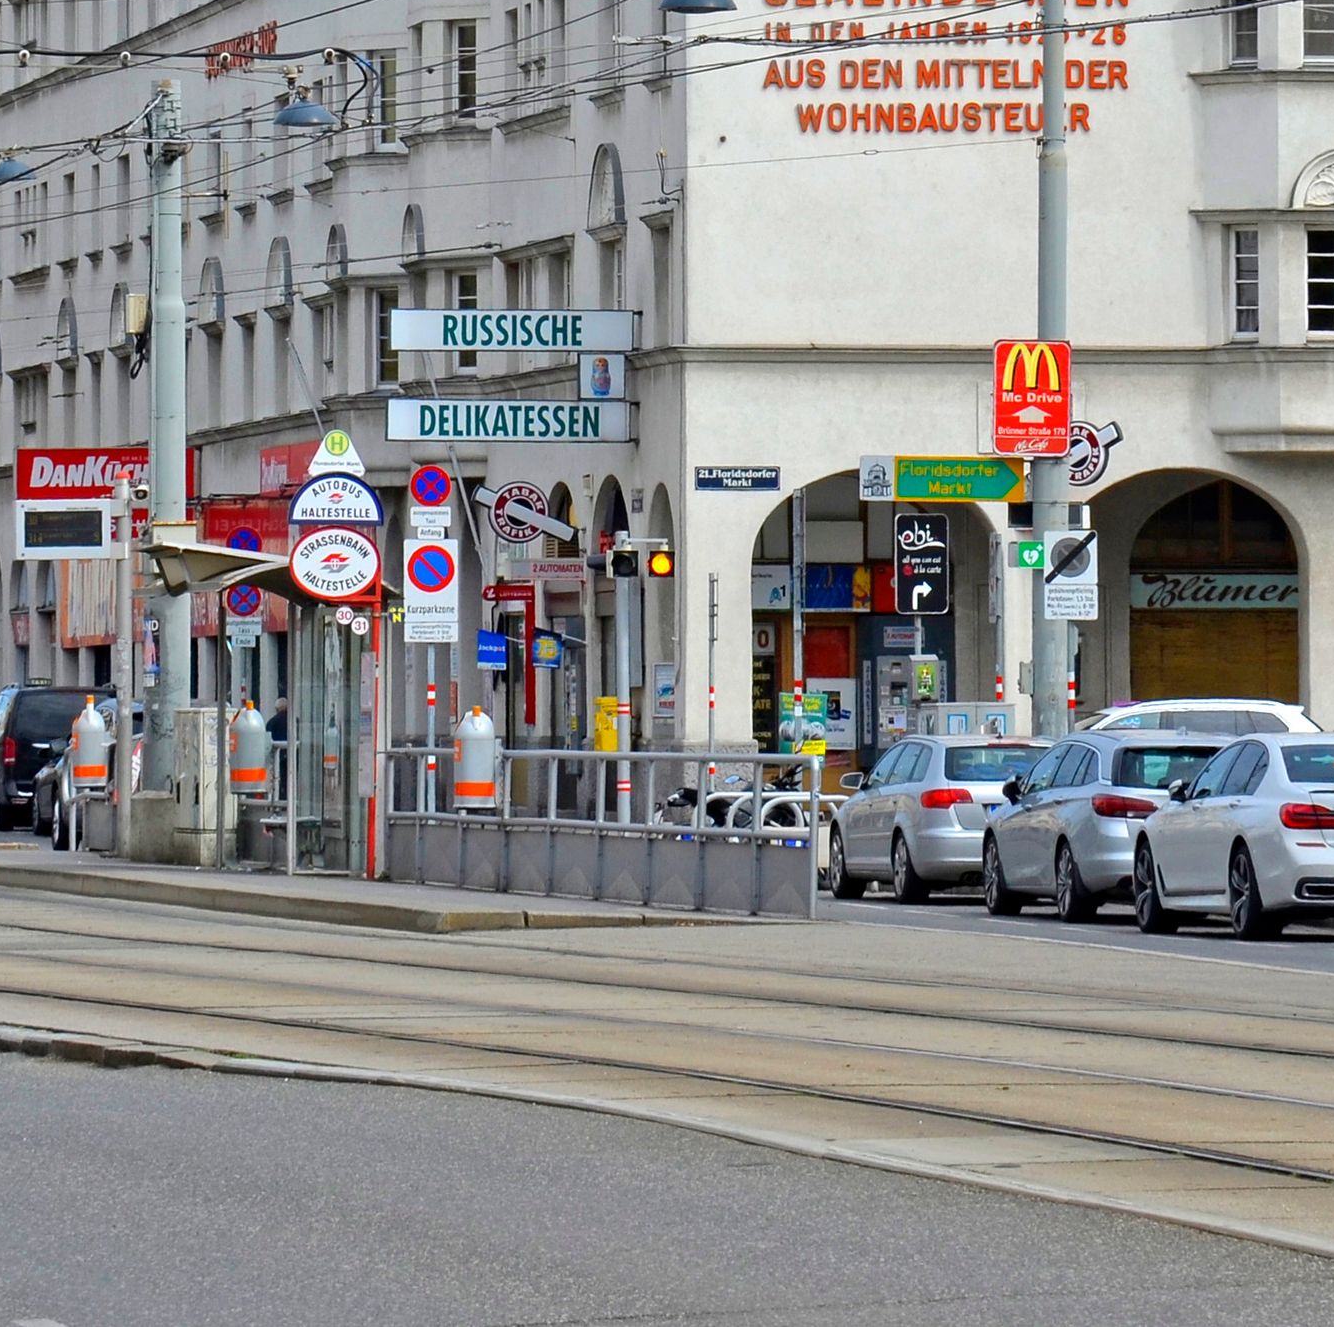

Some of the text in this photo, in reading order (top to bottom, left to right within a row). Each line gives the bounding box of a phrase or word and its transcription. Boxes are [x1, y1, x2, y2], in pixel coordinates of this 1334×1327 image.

[765, 21, 792, 44] IN
[810, 21, 865, 44] DEN
[881, 20, 988, 45] JAHREN
[763, 59, 826, 89] AUS
[840, 59, 903, 89] DEN
[1066, 59, 1129, 90] DER
[797, 101, 1091, 133] WOHNBAUSTEUR
[442, 314, 583, 346] RUSSISCHE
[1002, 392, 1063, 403] Mc Drive
[419, 404, 600, 438] DELIKATESSEN
[998, 426, 1066, 435] Brünner Straße 170
[331, 437, 343, 451] H
[900, 461, 999, 477] Floridsdorfer
[312, 480, 363, 498] AUTOBUS
[723, 478, 752, 487] Markt
[928, 481, 973, 495] Markt
[503, 486, 544, 510] TABAK
[301, 508, 371, 518] HALTESTELLE
[495, 508, 539, 538] TRAFIK
[419, 528, 442, 538] Anfang
[300, 534, 371, 559] STRASSENBAHN
[538, 564, 584, 573] AUTOMATEN
[302, 570, 368, 591] HALTESTELLE
[338, 610, 352, 620] 30
[407, 605, 455, 616] Kurzparkzone
[354, 620, 366, 630] 31
